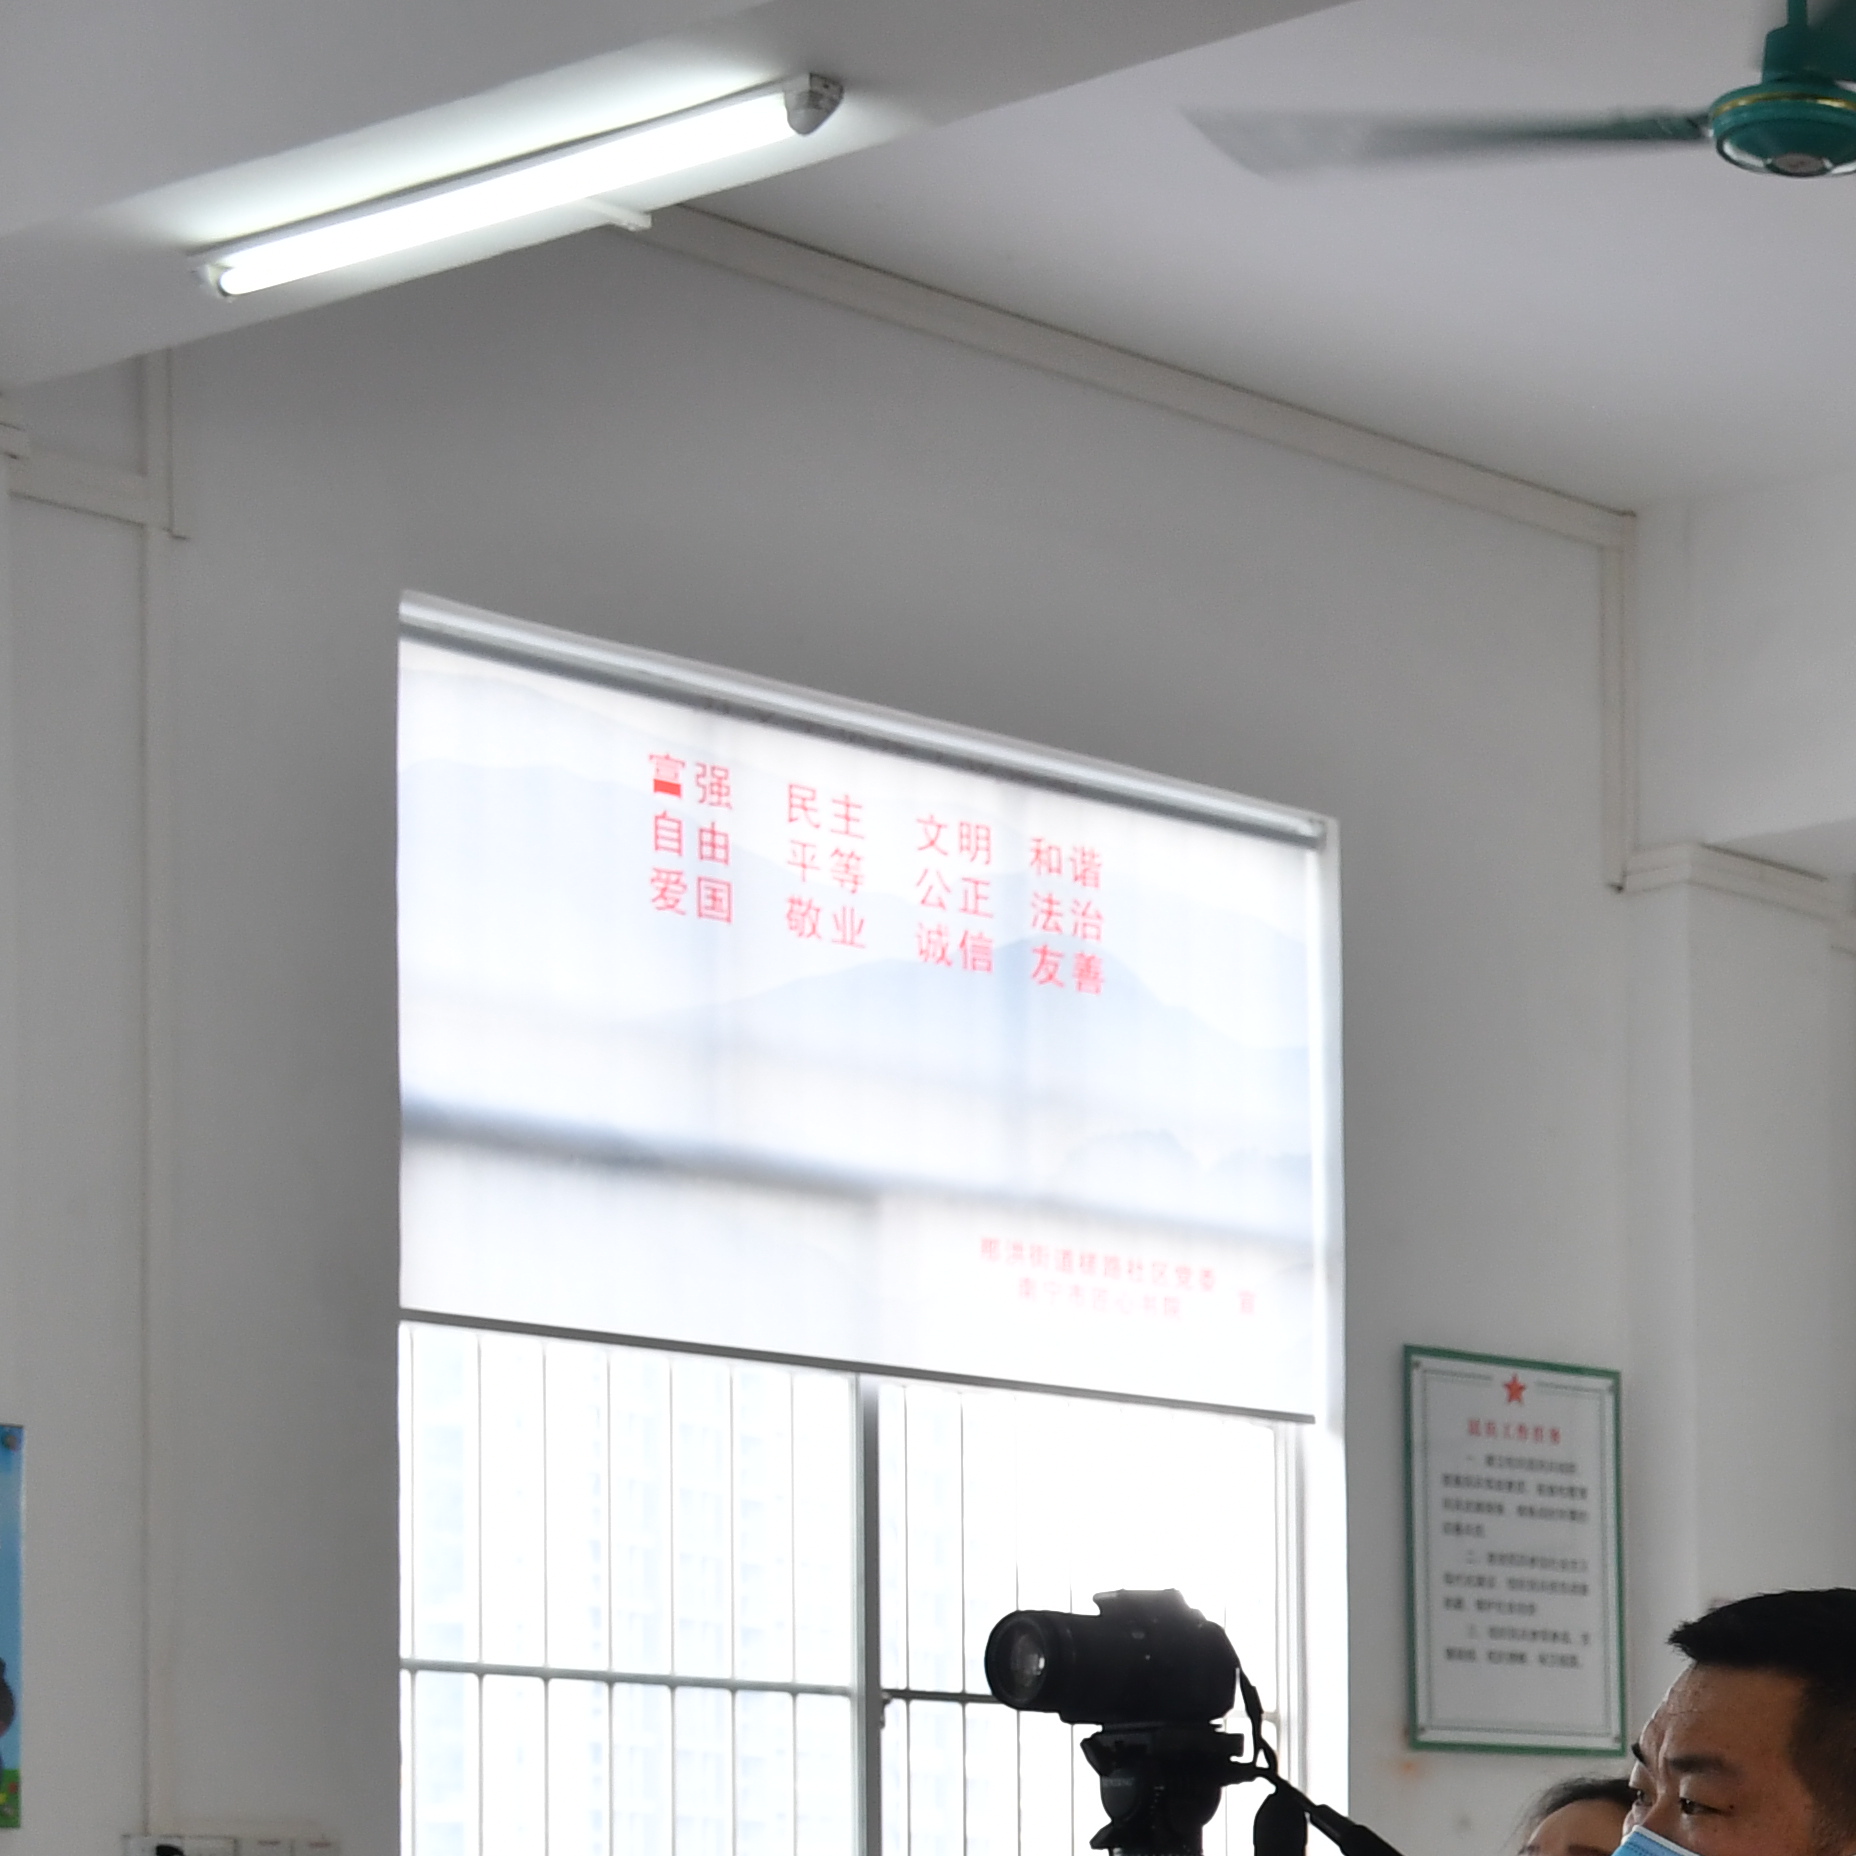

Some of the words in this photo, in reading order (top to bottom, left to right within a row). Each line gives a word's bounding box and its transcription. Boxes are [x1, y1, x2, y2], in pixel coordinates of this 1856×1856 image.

[648, 753, 733, 811] 富强
[787, 782, 864, 839] 民主
[916, 814, 993, 867] 文明
[1030, 837, 1103, 889] 和谐
[651, 810, 732, 868] 自由
[788, 840, 864, 896] 平等
[916, 868, 993, 919] 公正
[1031, 892, 1104, 943] 法治
[648, 866, 734, 924] 爱国
[785, 895, 866, 949] 敬业
[916, 924, 994, 975] 诚信
[1031, 943, 1105, 996] 友善
